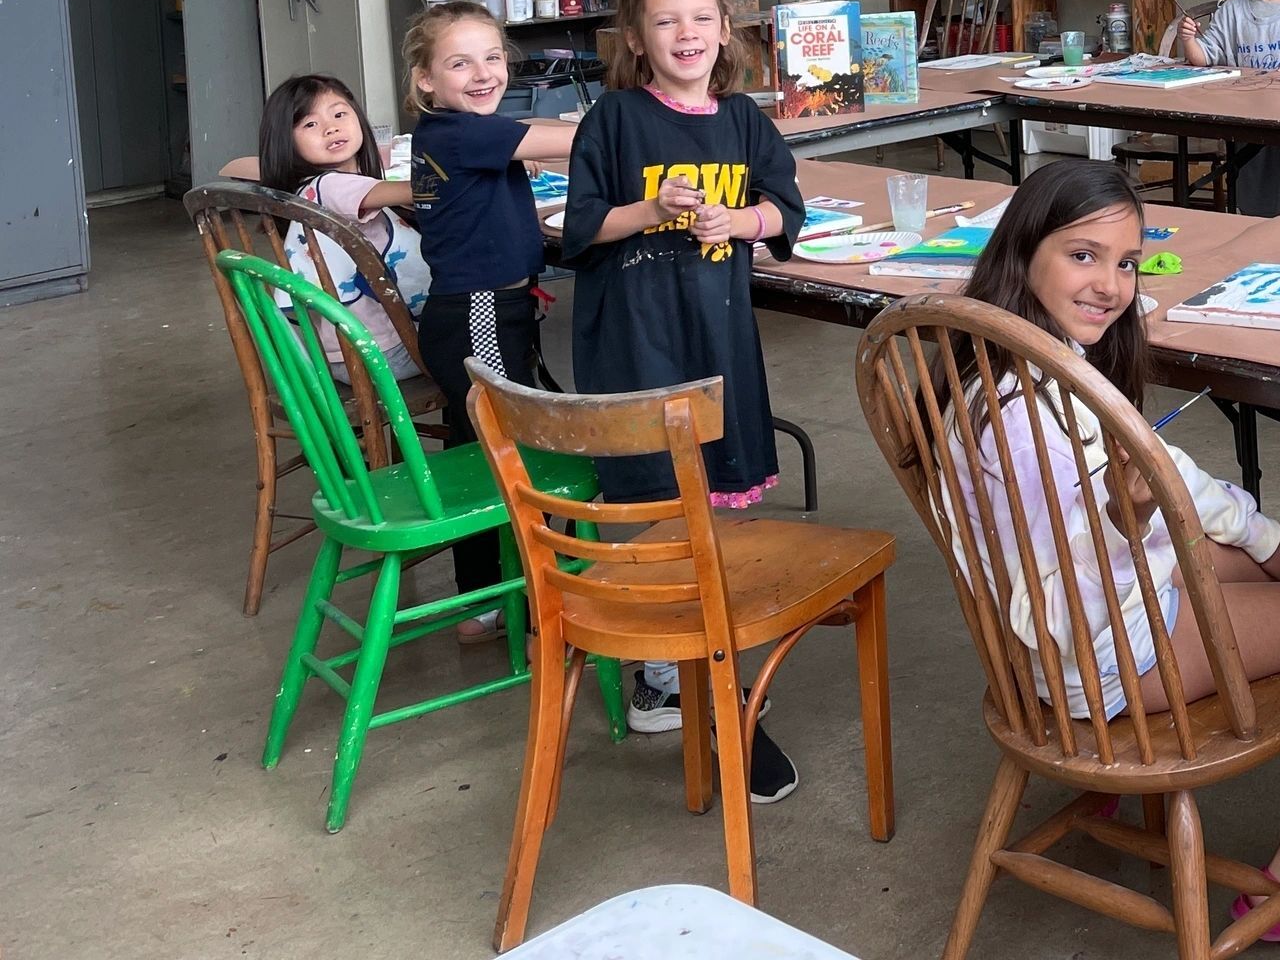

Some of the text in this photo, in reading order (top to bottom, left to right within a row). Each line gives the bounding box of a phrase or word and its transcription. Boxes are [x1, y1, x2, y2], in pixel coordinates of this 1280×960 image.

[798, 24, 812, 32] LIFE
[790, 30, 845, 45] CORAL
[865, 31, 900, 50] Reefs
[802, 43, 834, 57] REEF
[1254, 42, 1264, 52] is
[642, 163, 749, 208] IOW
